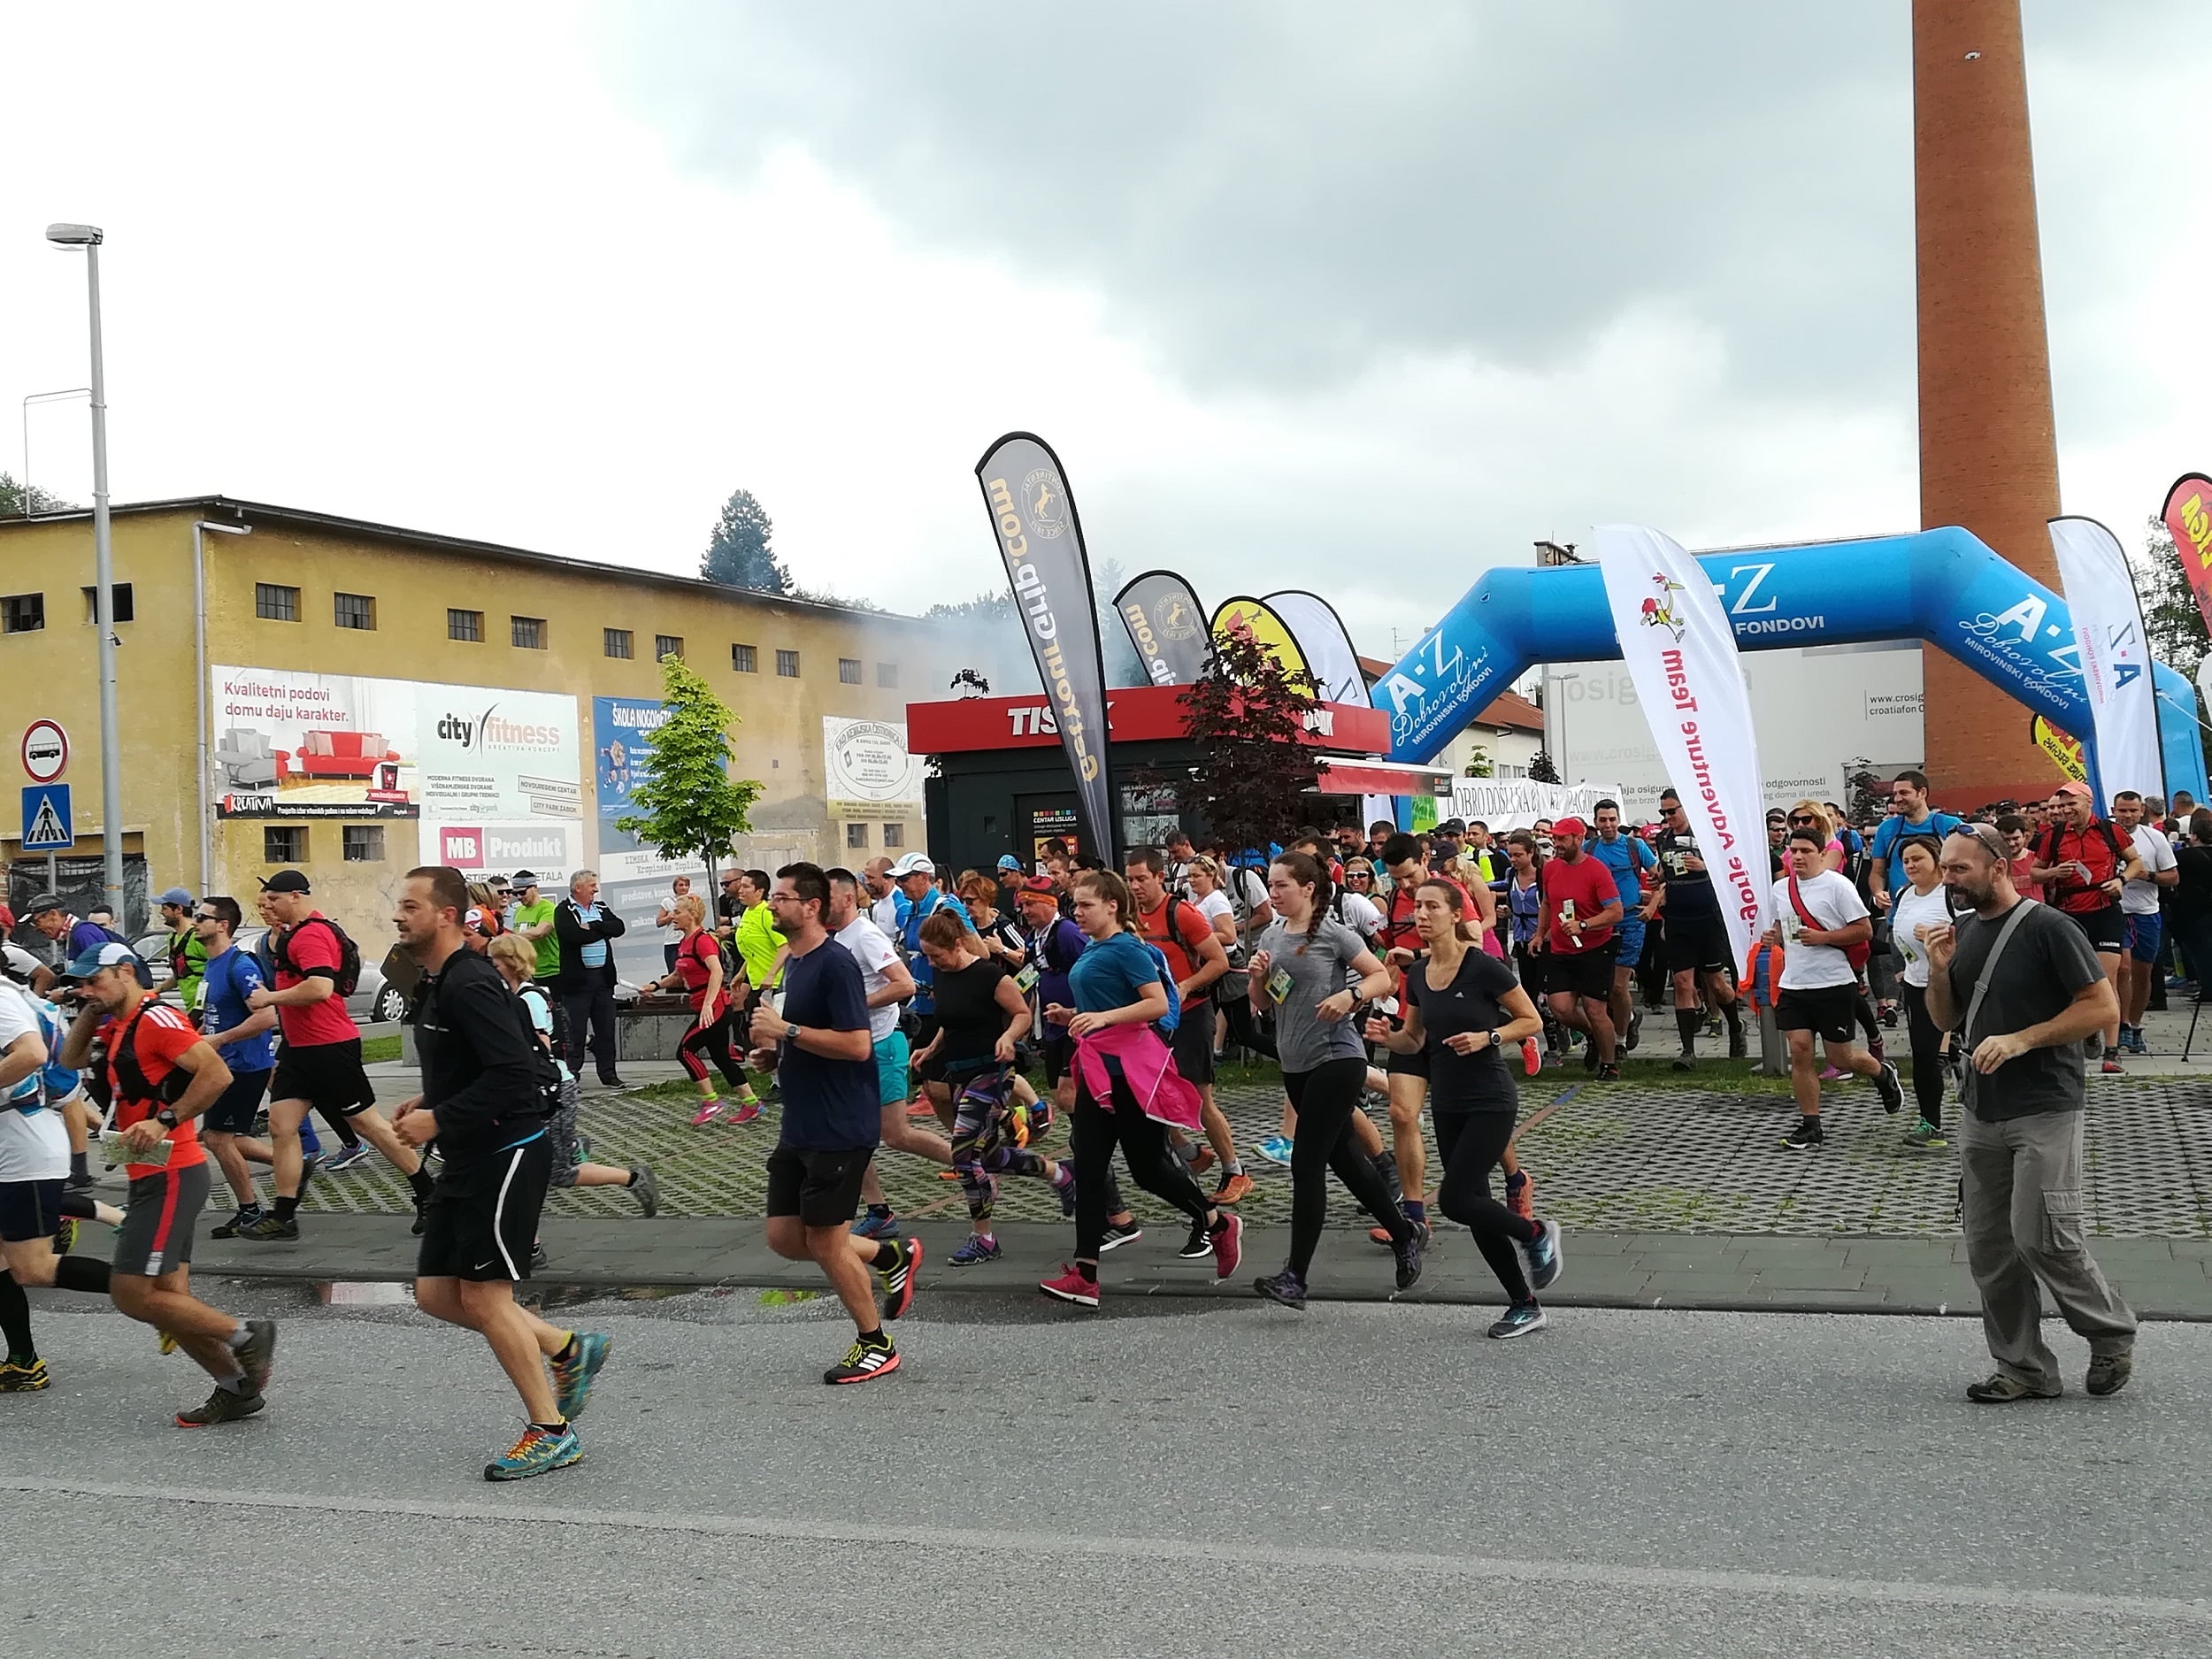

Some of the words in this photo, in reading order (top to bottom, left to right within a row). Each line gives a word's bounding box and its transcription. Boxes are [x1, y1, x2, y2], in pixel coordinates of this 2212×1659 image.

[1735, 615, 1825, 636] FONDOVI
[1964, 636, 2024, 680] MIROVINSKI
[2024, 676, 2070, 710] FONDOVI
[224, 681, 286, 699] Kvalitetni
[288, 687, 330, 703] podovi
[225, 702, 263, 717] domu
[265, 704, 293, 722] daju
[296, 706, 349, 723] karakter.
[611, 702, 635, 727] ŠKOLA
[1411, 699, 1459, 745] MIROVINSKI
[1456, 666, 1494, 703] FONDOVI
[1870, 704, 1917, 716] croatiafon
[436, 712, 472, 748] city
[486, 715, 561, 746] fitness
[1765, 776, 1826, 789] odgovornosti
[1447, 787, 1485, 817] DOBRO
[445, 836, 477, 859] MB
[489, 836, 563, 859] Produkt
